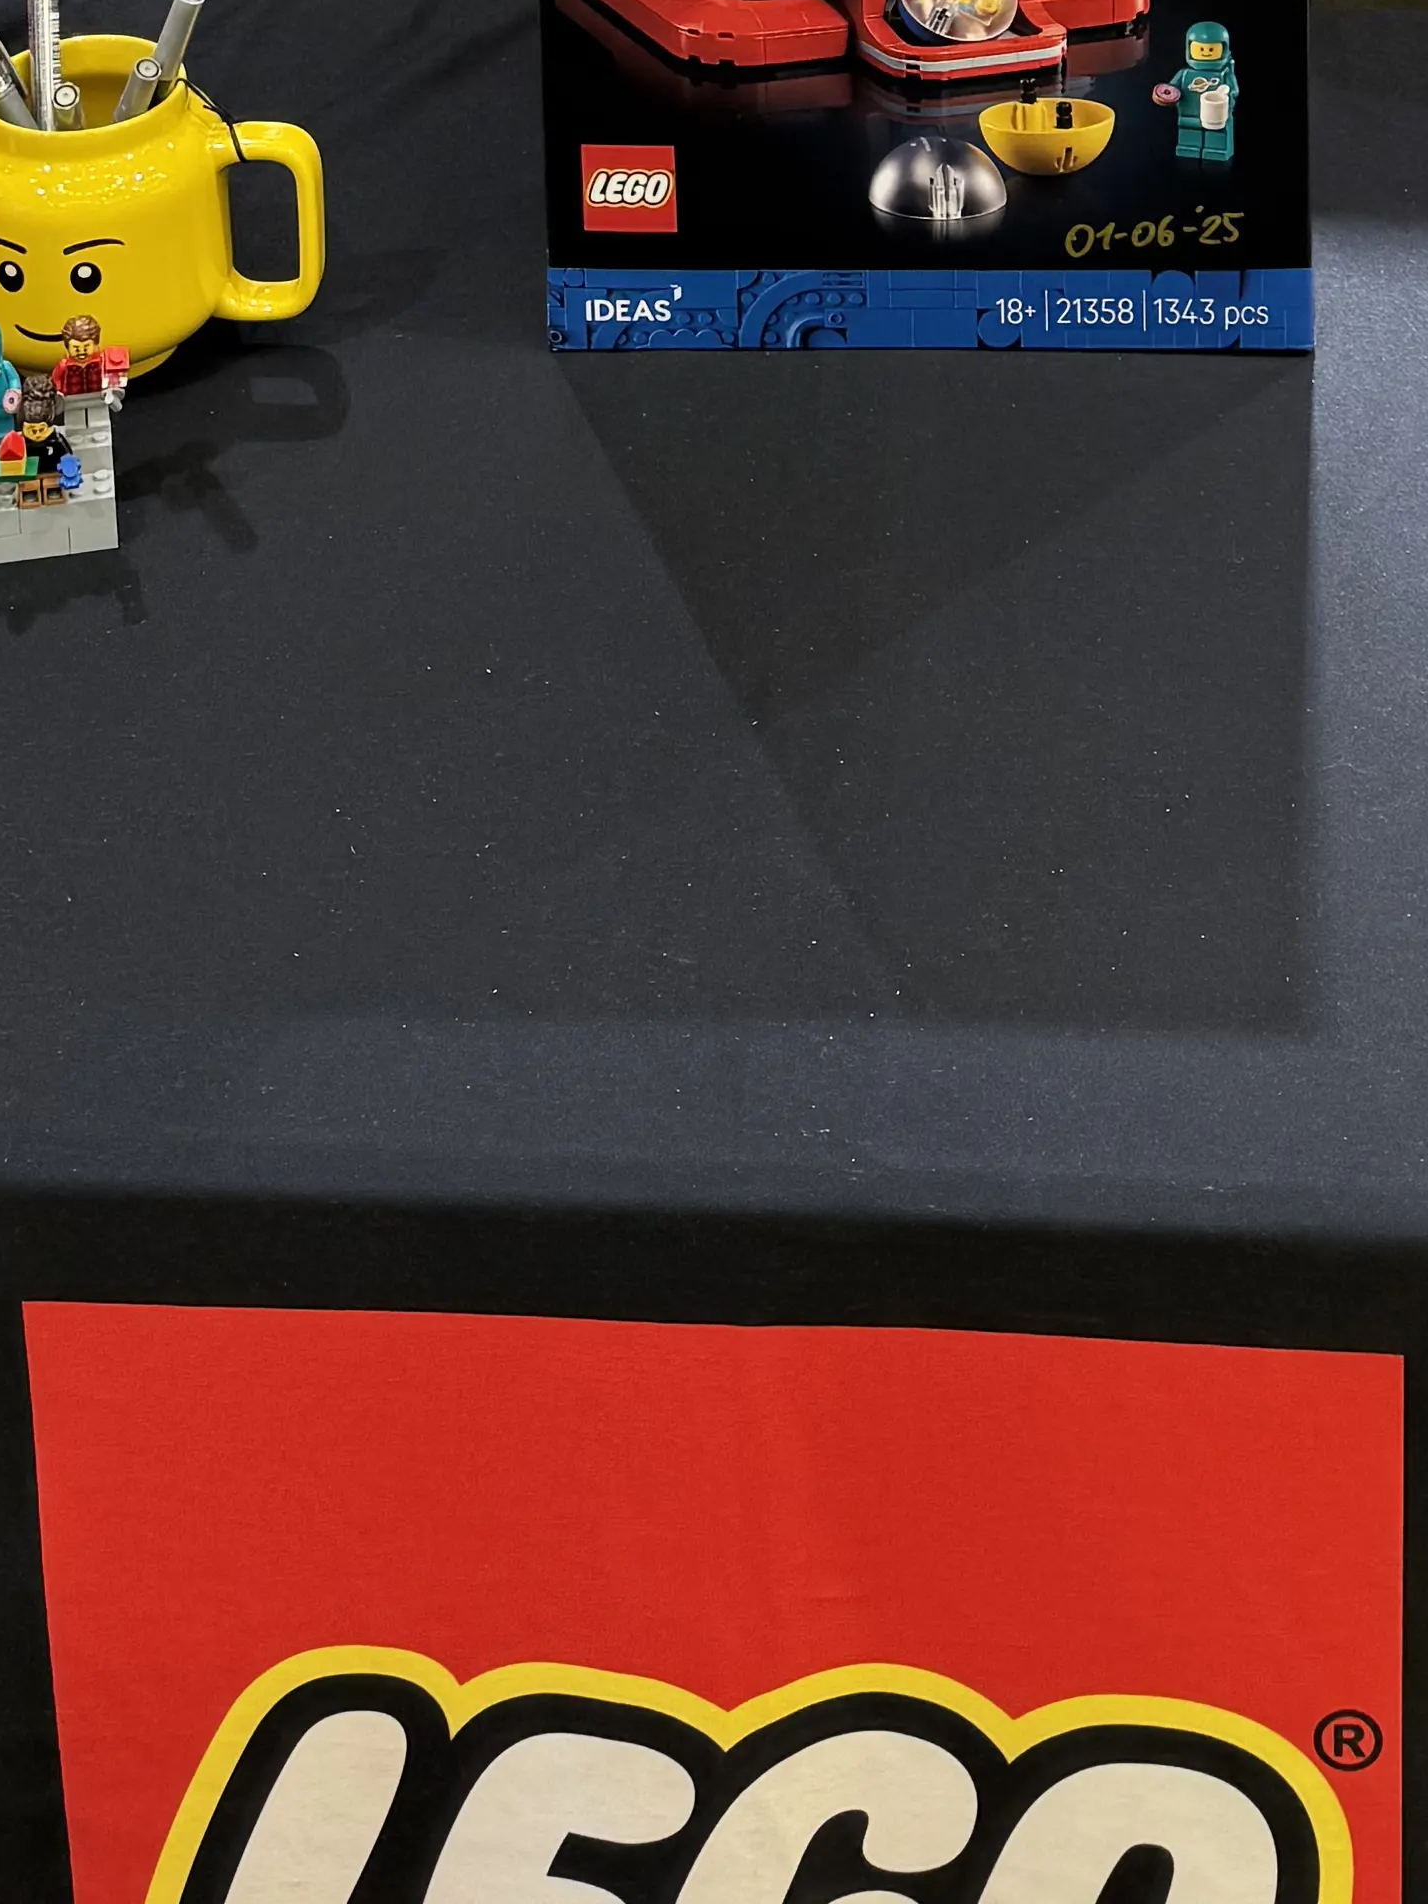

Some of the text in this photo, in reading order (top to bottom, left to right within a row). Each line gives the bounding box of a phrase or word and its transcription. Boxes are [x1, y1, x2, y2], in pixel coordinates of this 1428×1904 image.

[587, 168, 670, 205] LEGO
[584, 297, 672, 323] IDEAS
[995, 297, 1270, 330] 18+ 21358 1343 pcs
